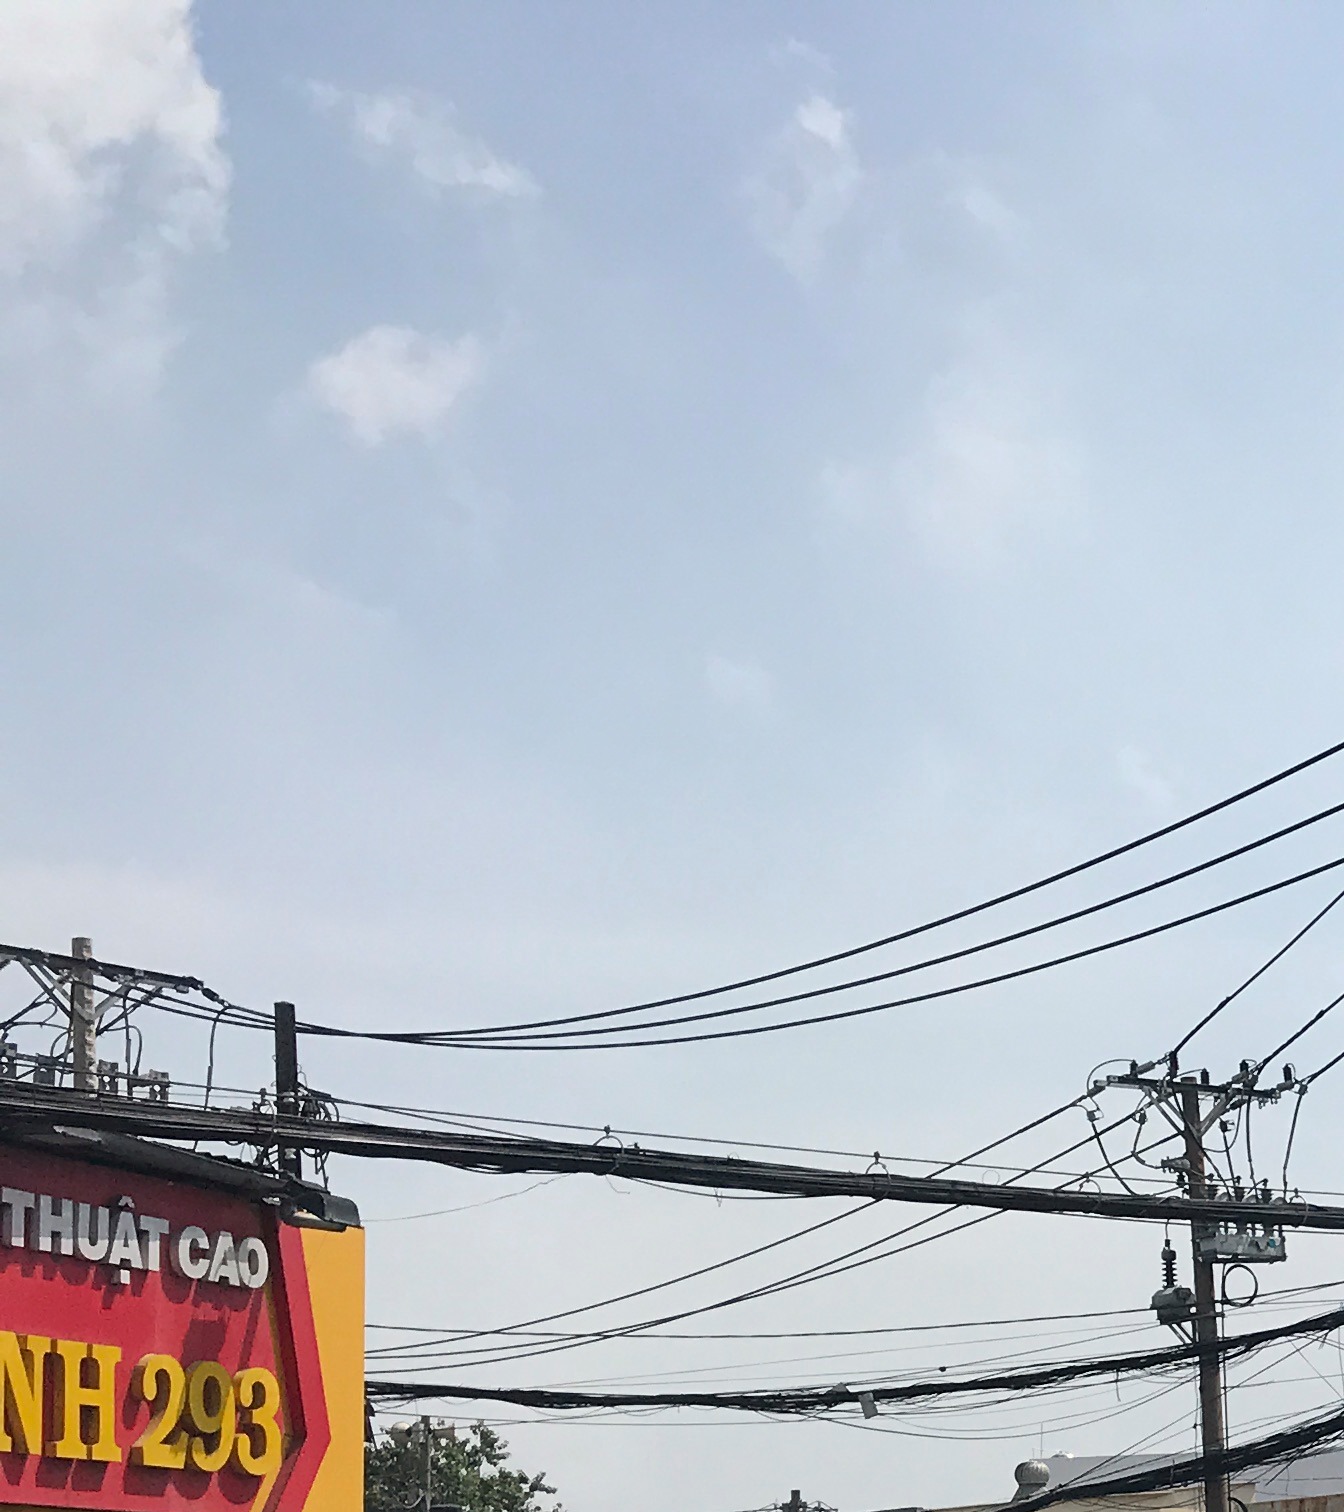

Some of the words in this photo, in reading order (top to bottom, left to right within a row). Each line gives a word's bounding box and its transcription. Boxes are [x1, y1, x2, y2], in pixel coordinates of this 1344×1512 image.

[2, 1187, 169, 1284] THUẬT
[178, 1226, 269, 1289] CAO
[137, 1353, 282, 1476] 293
